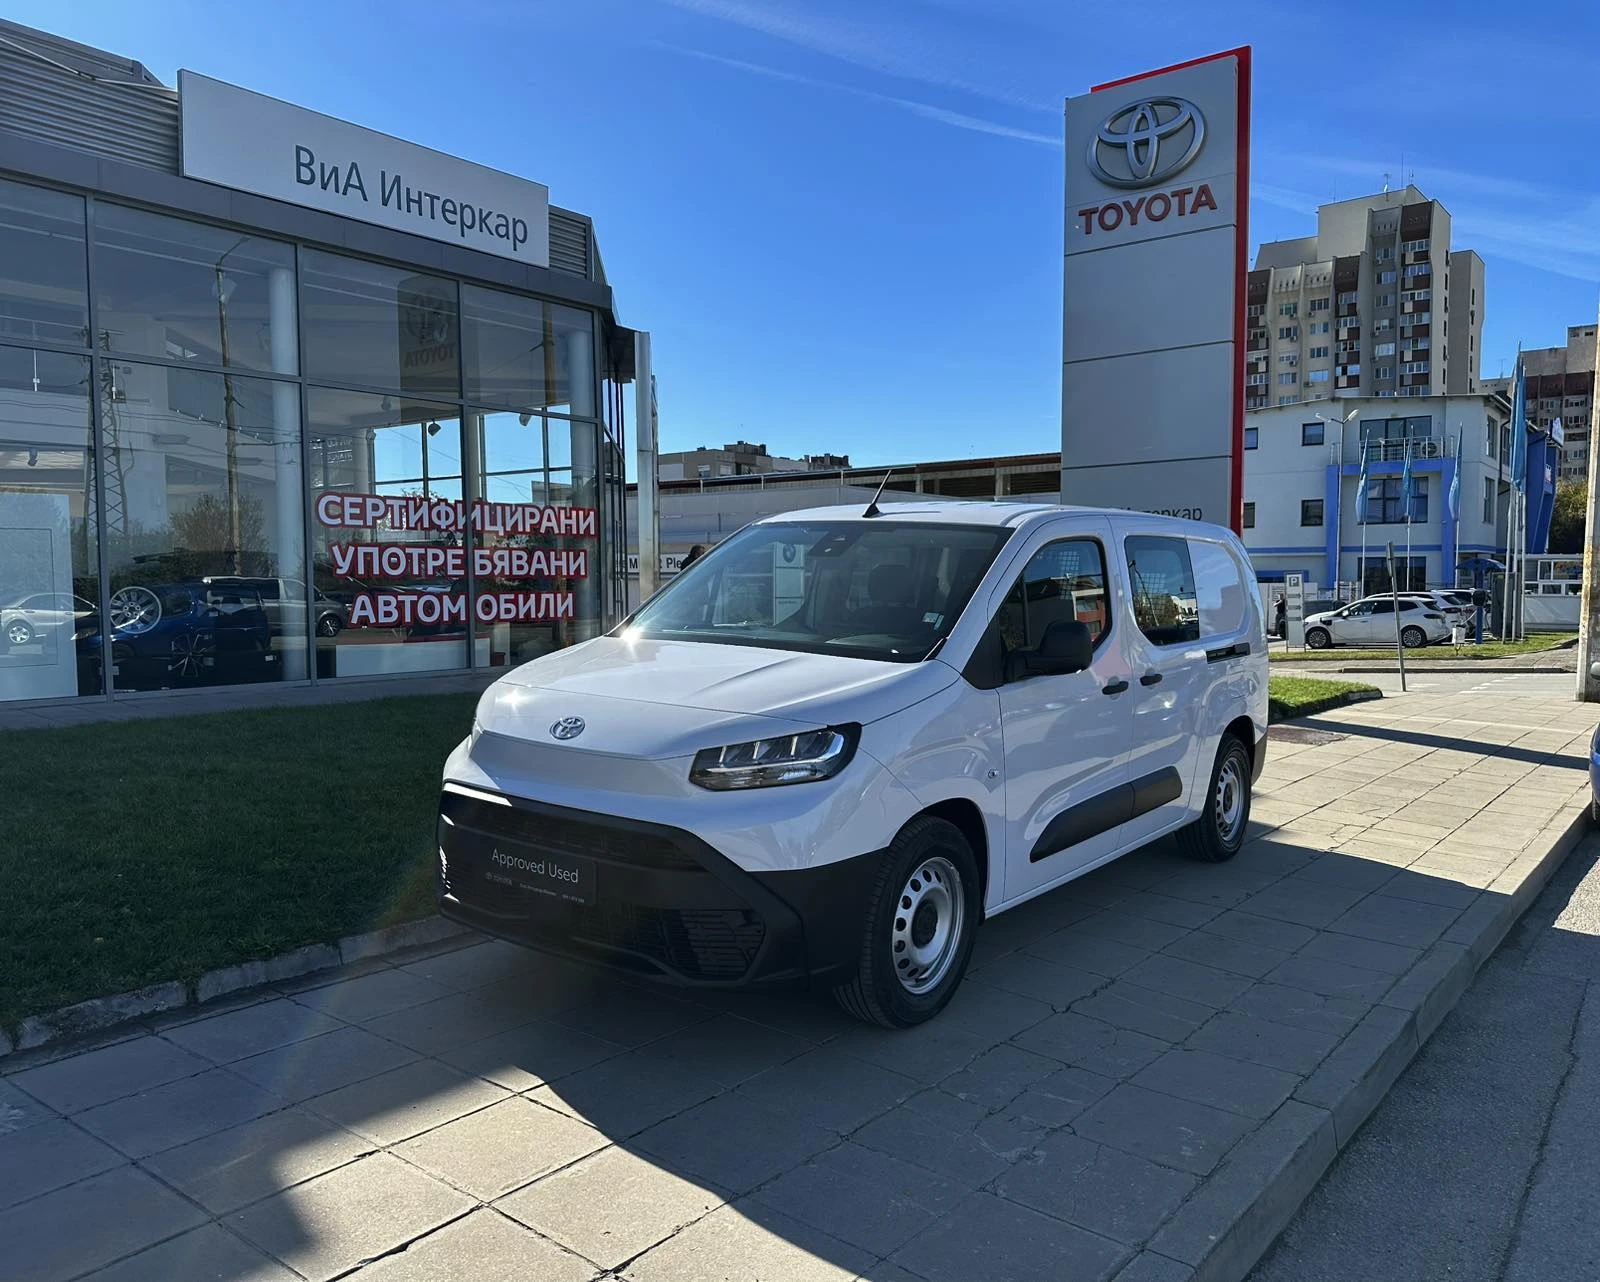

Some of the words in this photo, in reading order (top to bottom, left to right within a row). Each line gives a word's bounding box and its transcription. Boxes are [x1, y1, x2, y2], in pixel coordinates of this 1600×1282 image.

[295, 144, 368, 202] ВиА
[380, 170, 528, 252] Интеркар
[1078, 183, 1217, 235] TOYOTA
[318, 494, 596, 536] СЕРТИФИЦИРАНИ
[492, 848, 545, 875] Approved
[548, 862, 579, 883] Used
